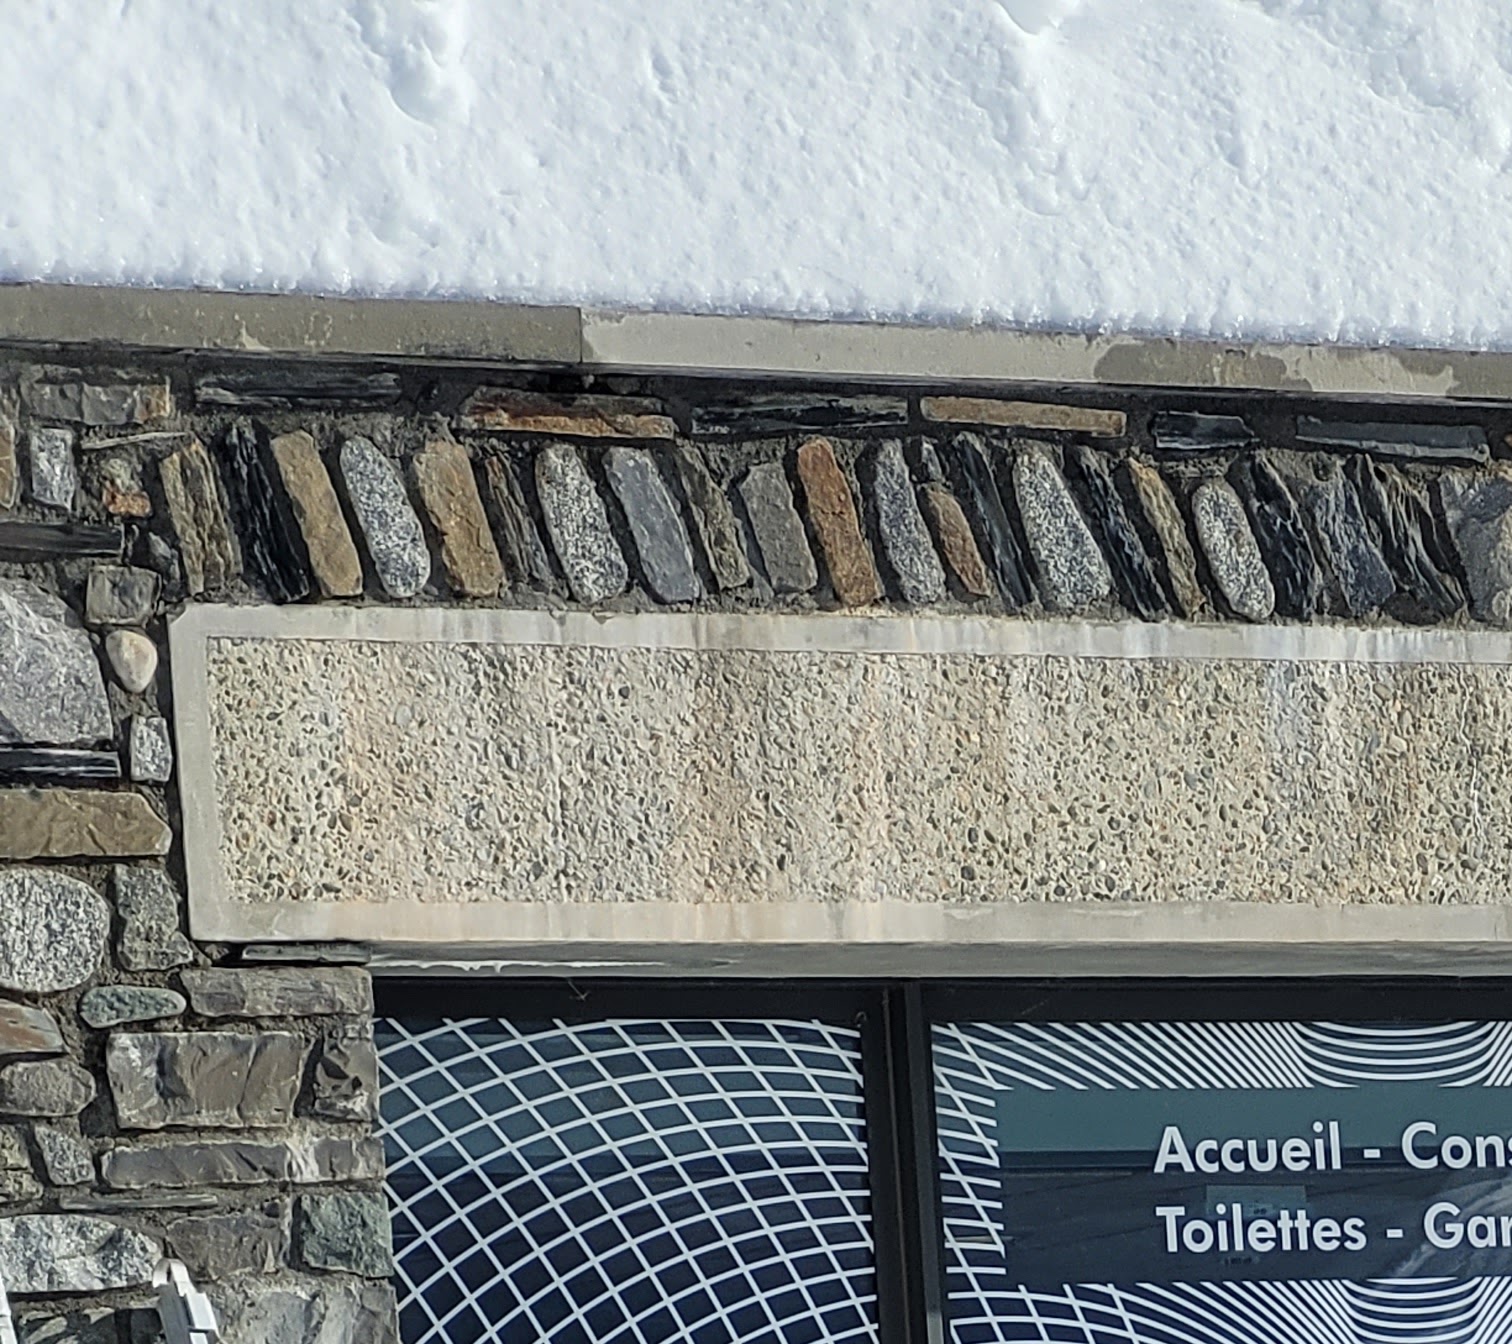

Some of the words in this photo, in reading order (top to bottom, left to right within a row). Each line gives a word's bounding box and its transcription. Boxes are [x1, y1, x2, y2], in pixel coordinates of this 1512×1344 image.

[1154, 1120, 1343, 1174] Accueil
[1362, 1147, 1383, 1160] -
[1155, 1203, 1368, 1254] Toilettes
[1386, 1228, 1405, 1240] -
